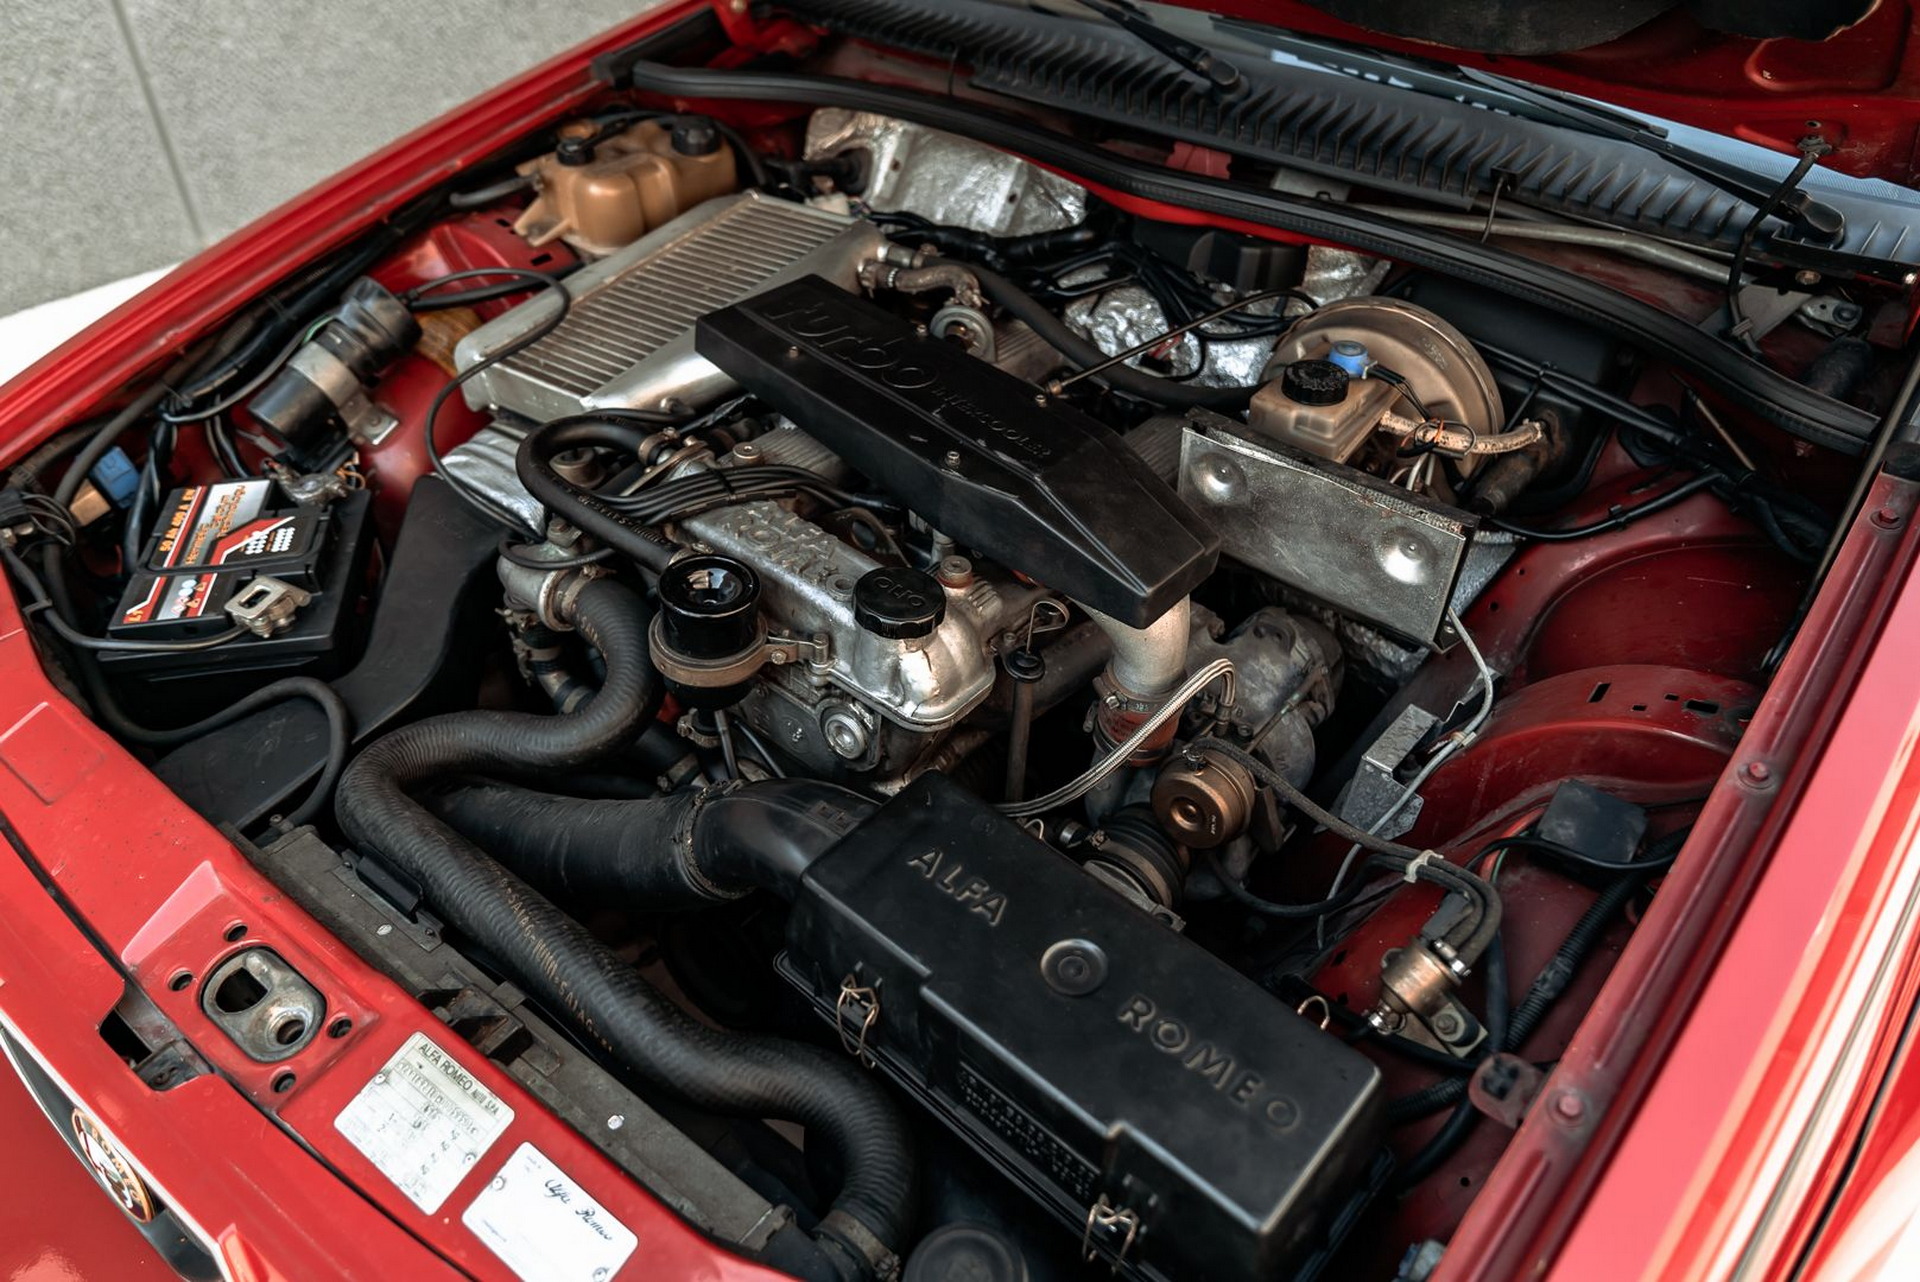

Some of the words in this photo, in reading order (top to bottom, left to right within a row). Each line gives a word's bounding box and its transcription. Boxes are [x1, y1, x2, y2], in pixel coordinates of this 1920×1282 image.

[159, 540, 173, 552] 50
[874, 576, 926, 608] OLIO
[907, 846, 1008, 927] ALFA
[418, 1043, 442, 1065] ALFA
[440, 1060, 474, 1091] ROMEO
[1116, 993, 1301, 1137] ROMEO
[544, 1179, 571, 1205] Alfa
[575, 1206, 613, 1241] Romeo
